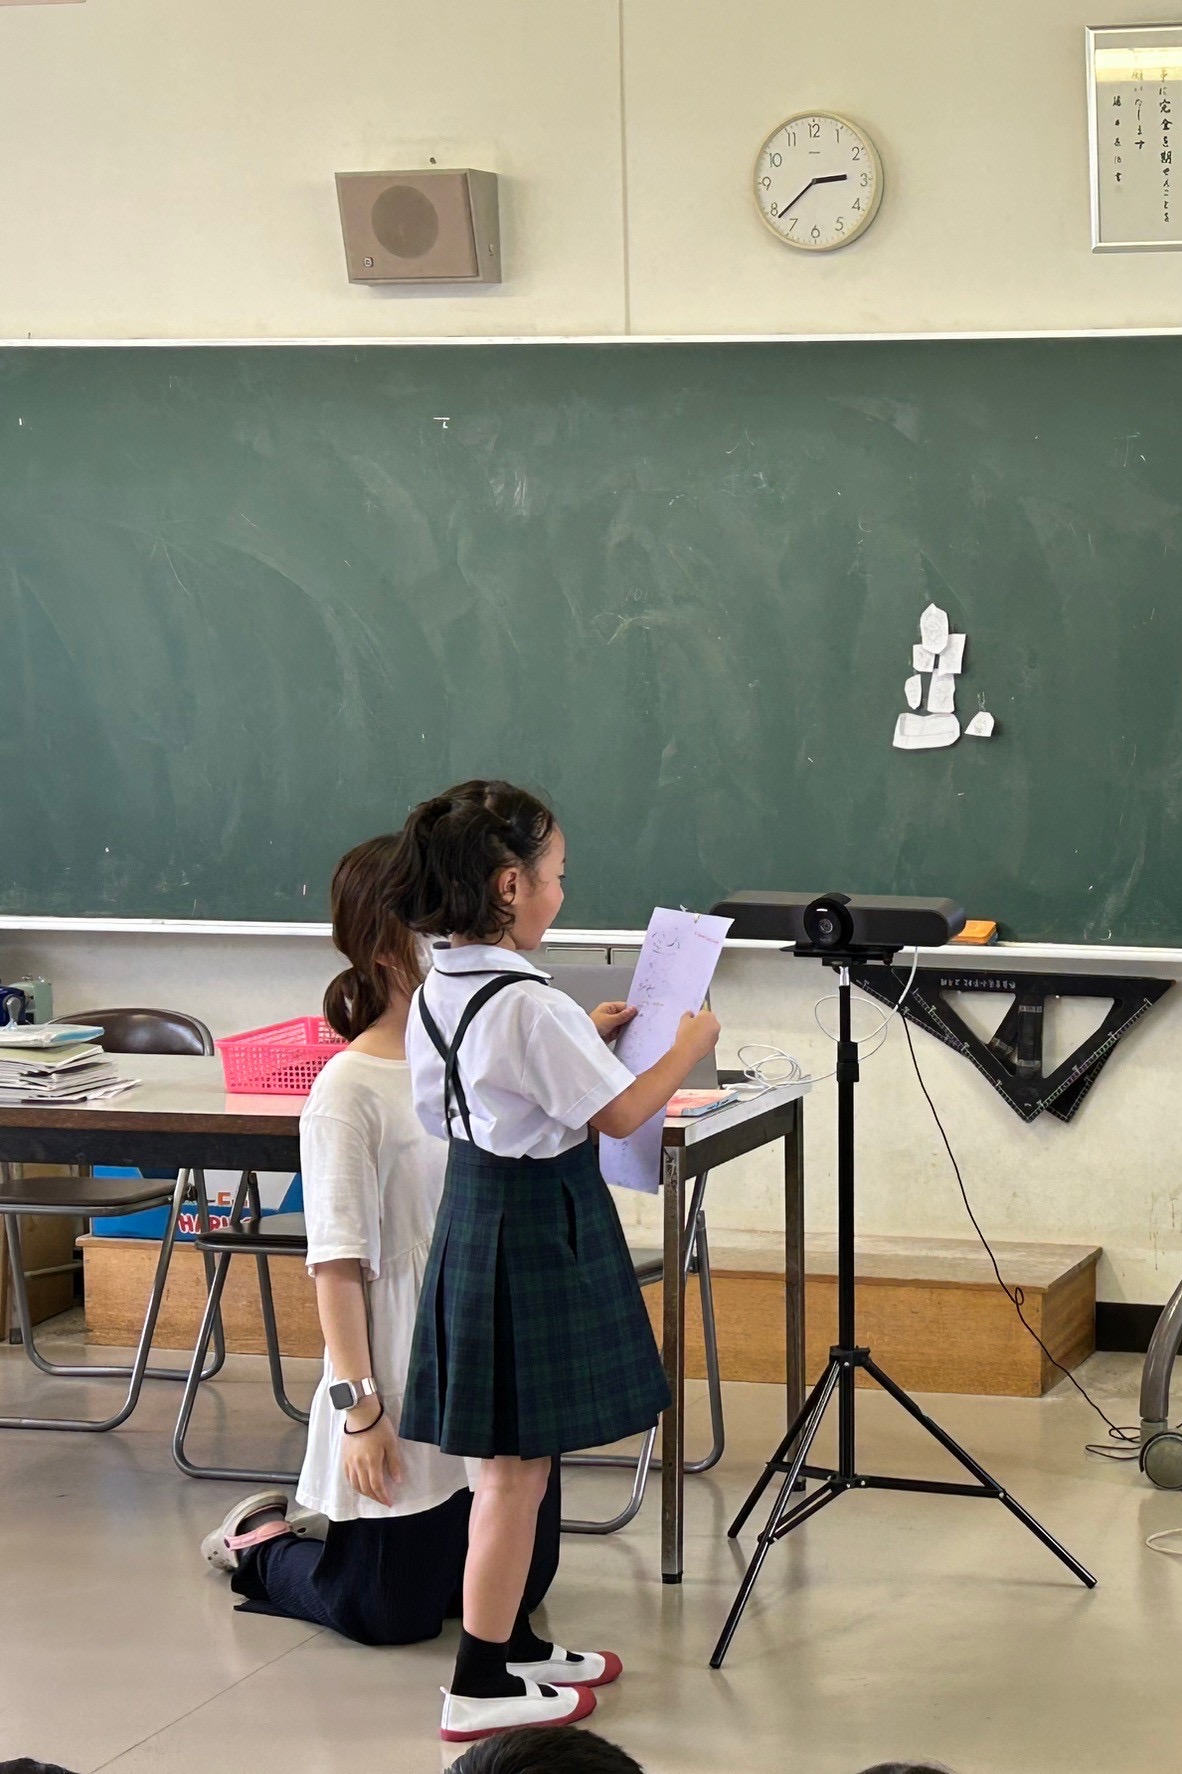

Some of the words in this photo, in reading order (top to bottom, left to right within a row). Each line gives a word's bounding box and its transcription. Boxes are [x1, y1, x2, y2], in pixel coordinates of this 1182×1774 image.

[808, 123, 820, 138] 12
[835, 128, 840, 143] 1
[787, 131, 797, 146] 11
[769, 152, 783, 168] 10
[851, 146, 860, 161] 2
[761, 176, 772, 190] 9
[860, 173, 868, 187] 3
[770, 202, 779, 217] 8
[851, 198, 861, 211] 4
[789, 218, 798, 232] 7
[835, 216, 845, 232] 5
[811, 225, 821, 239] 6
